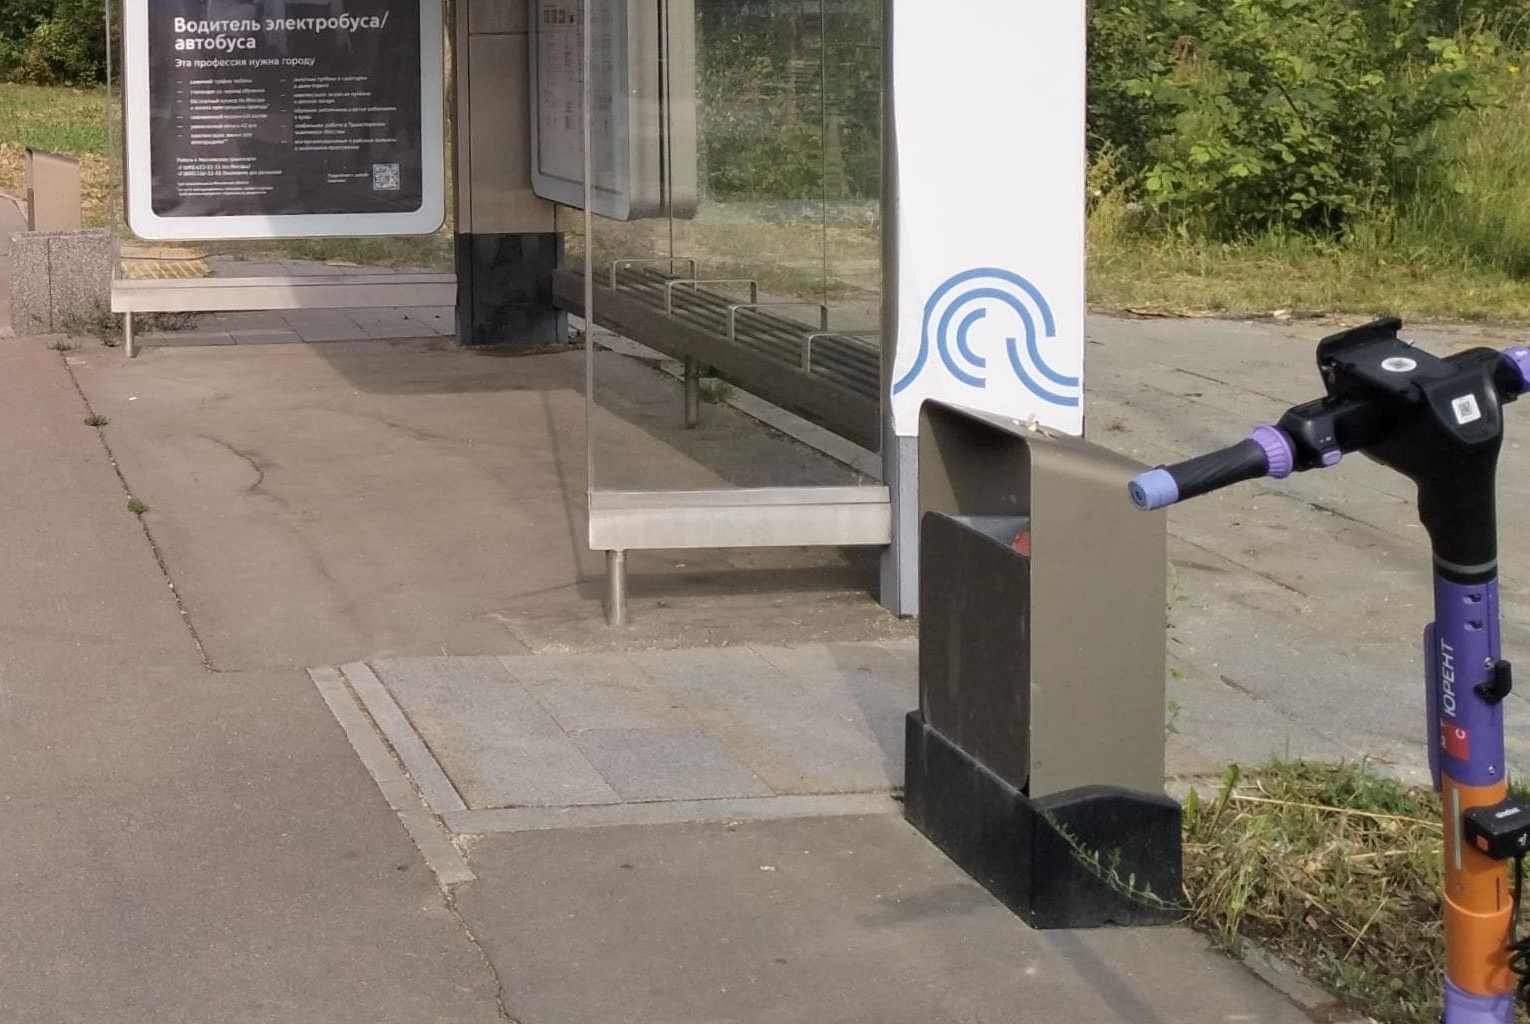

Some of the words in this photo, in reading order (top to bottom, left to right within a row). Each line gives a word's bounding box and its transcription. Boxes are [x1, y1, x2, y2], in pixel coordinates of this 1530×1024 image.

[173, 17, 261, 34] Водитель
[265, 11, 389, 33] электробуса/
[174, 34, 257, 53] автобуса
[175, 58, 192, 68] Эта
[194, 57, 247, 69] профессия
[249, 58, 279, 68] нужна
[282, 57, 316, 67] городу
[1441, 638, 1457, 718] ЮРЕНТ
